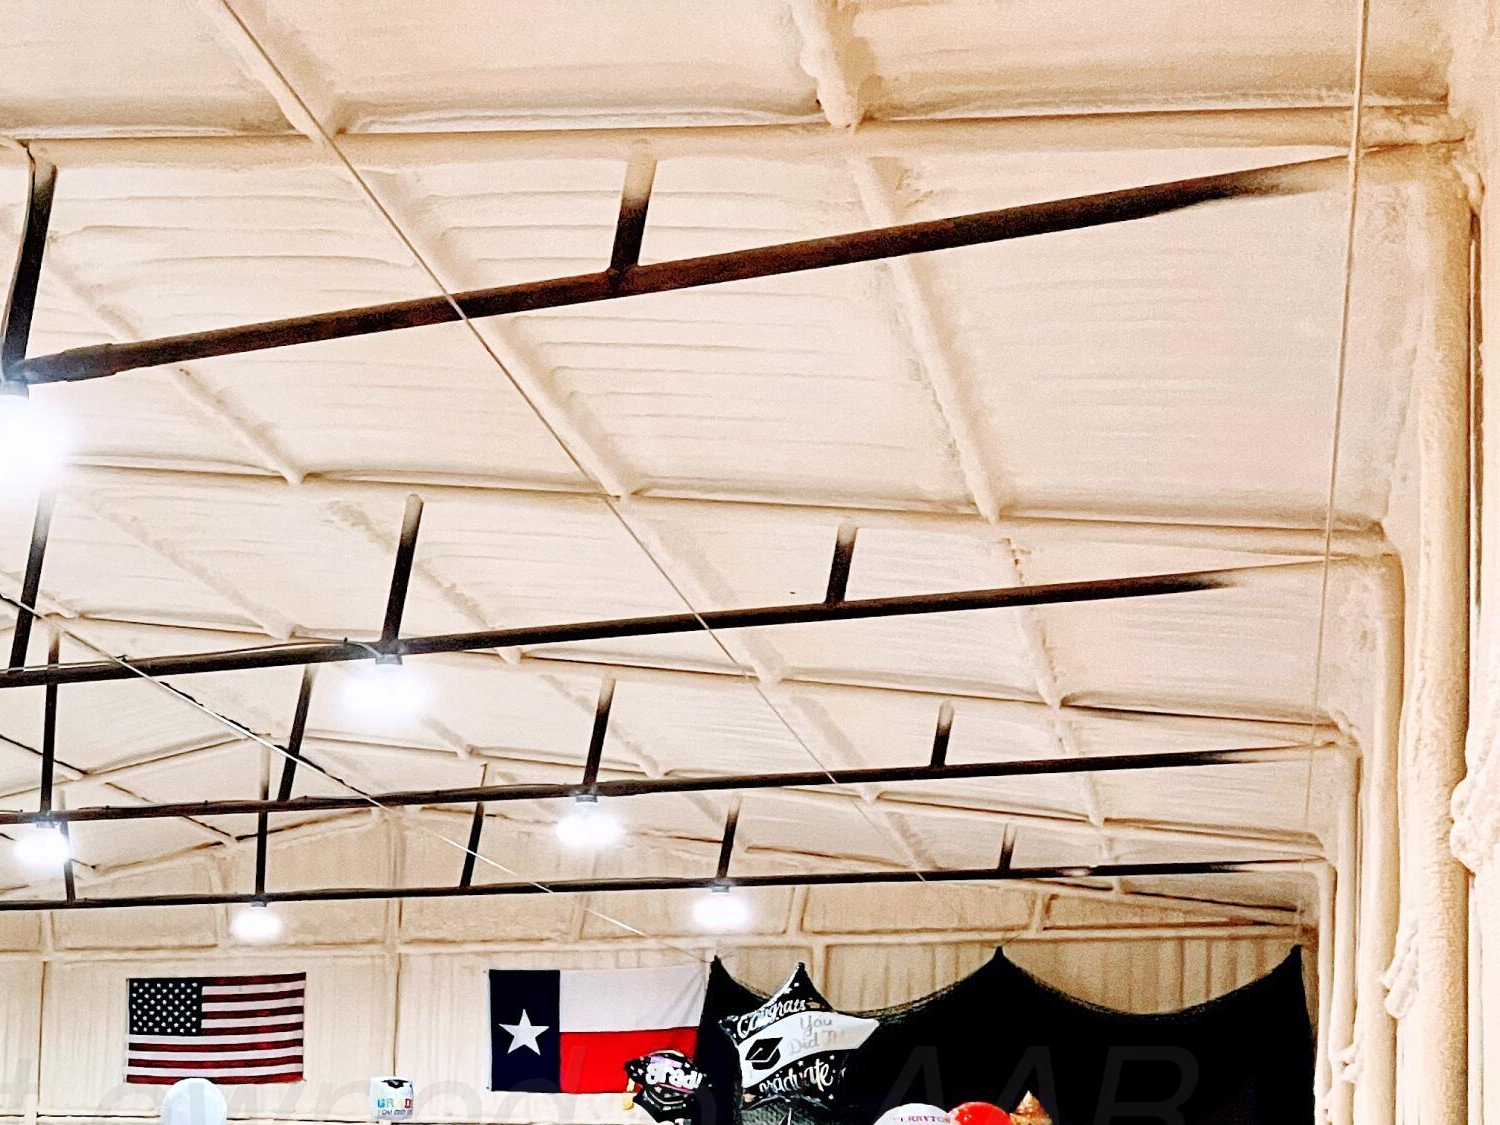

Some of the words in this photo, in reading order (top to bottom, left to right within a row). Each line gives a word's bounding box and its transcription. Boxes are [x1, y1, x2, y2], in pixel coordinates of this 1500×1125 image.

[737, 999, 806, 1039] Congrats
[801, 1016, 833, 1037] You
[790, 1032, 819, 1054] Did
[893, 1115, 951, 1123] RRYTON
